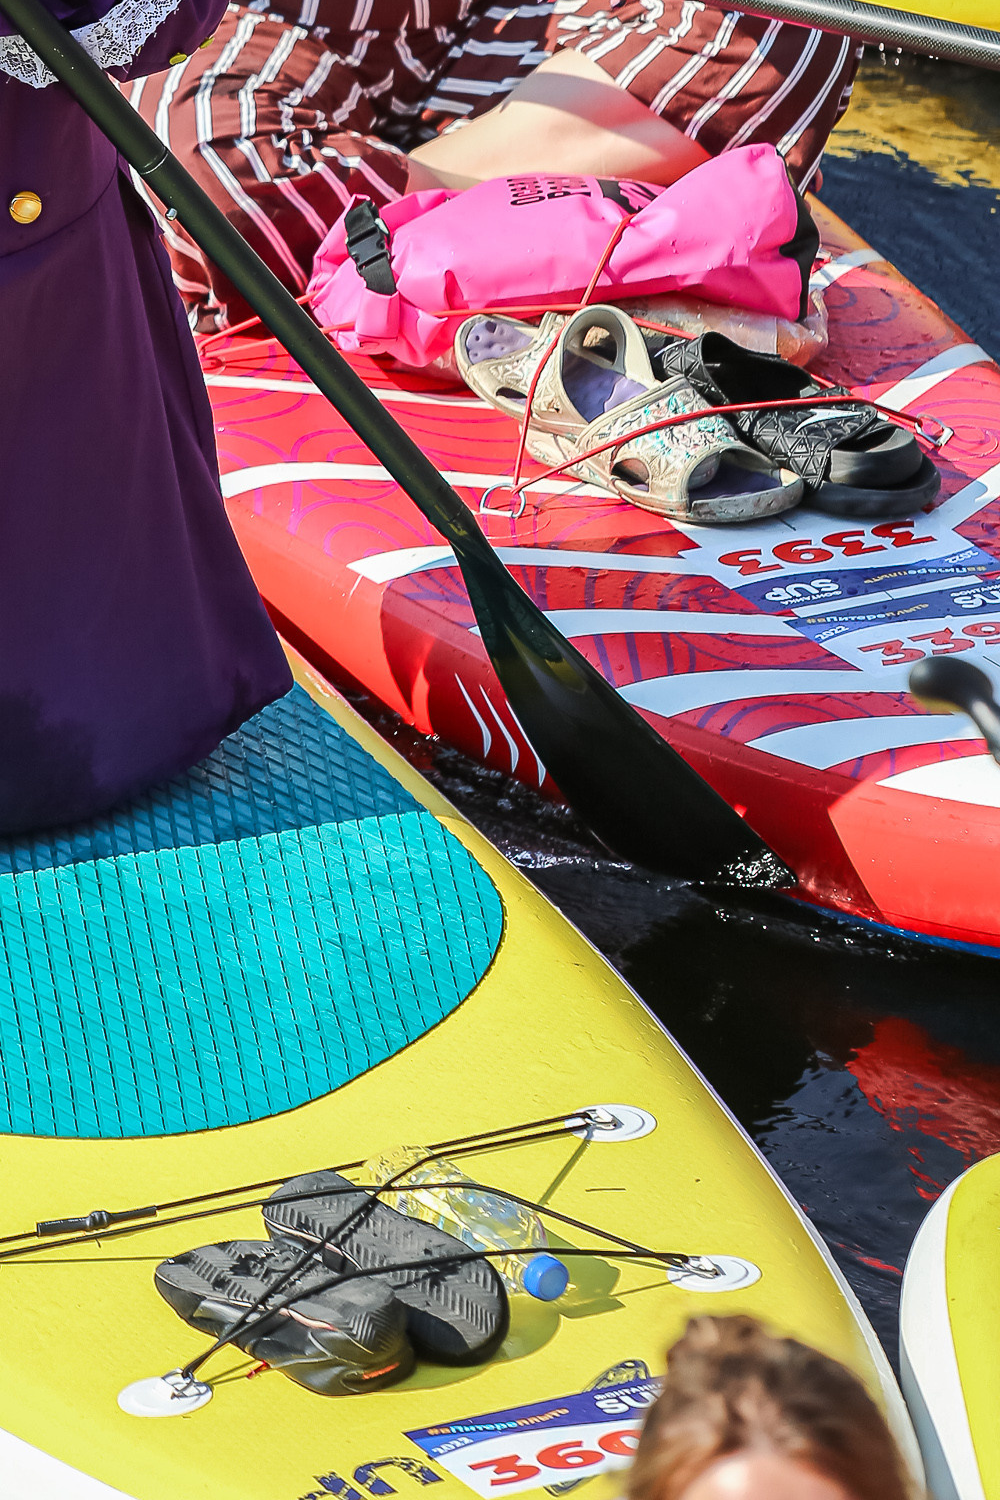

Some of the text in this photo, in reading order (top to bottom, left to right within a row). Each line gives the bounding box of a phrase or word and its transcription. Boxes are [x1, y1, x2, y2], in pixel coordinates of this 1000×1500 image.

[717, 521, 937, 576] 3393
[944, 550, 979, 563] 2022
[765, 578, 839, 602] SUP
[814, 625, 850, 640] 2022
[595, 1388, 662, 1415] SU
[431, 1436, 475, 1455] 2022
